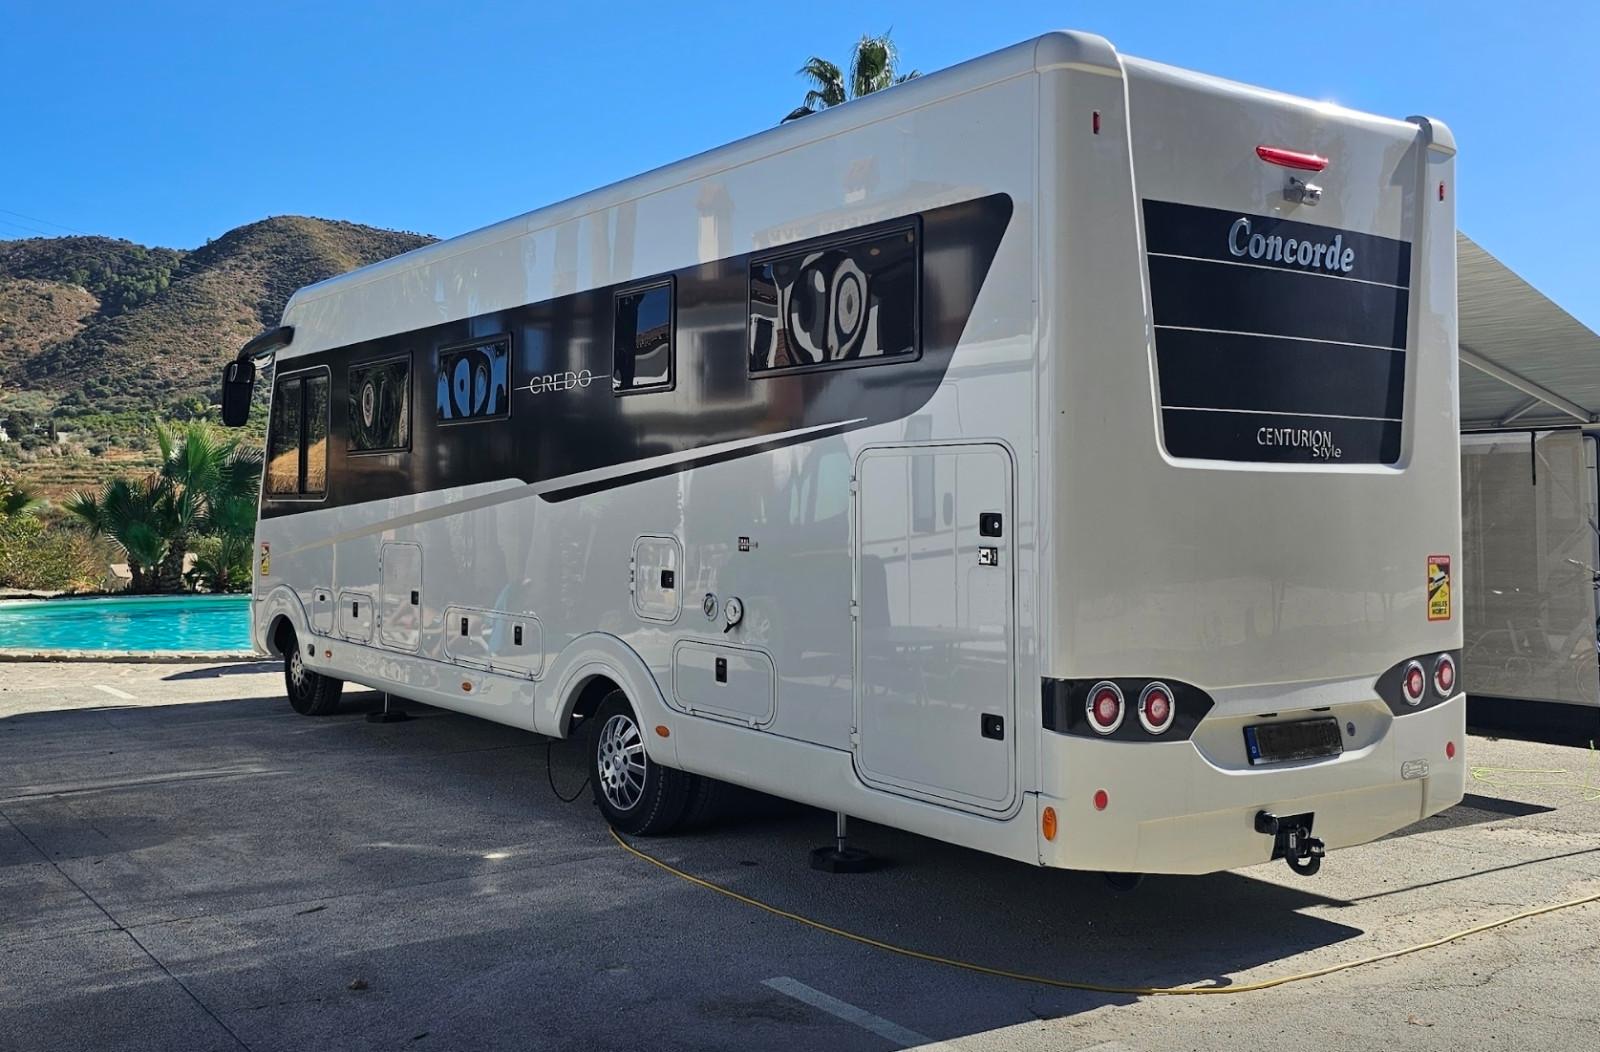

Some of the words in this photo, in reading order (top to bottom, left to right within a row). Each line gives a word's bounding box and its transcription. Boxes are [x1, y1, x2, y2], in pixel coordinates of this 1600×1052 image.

[1228, 217, 1355, 272] Concorde
[530, 369, 592, 394] CREDO
[1257, 427, 1332, 447] CENTURION
[1312, 444, 1342, 460] Style
